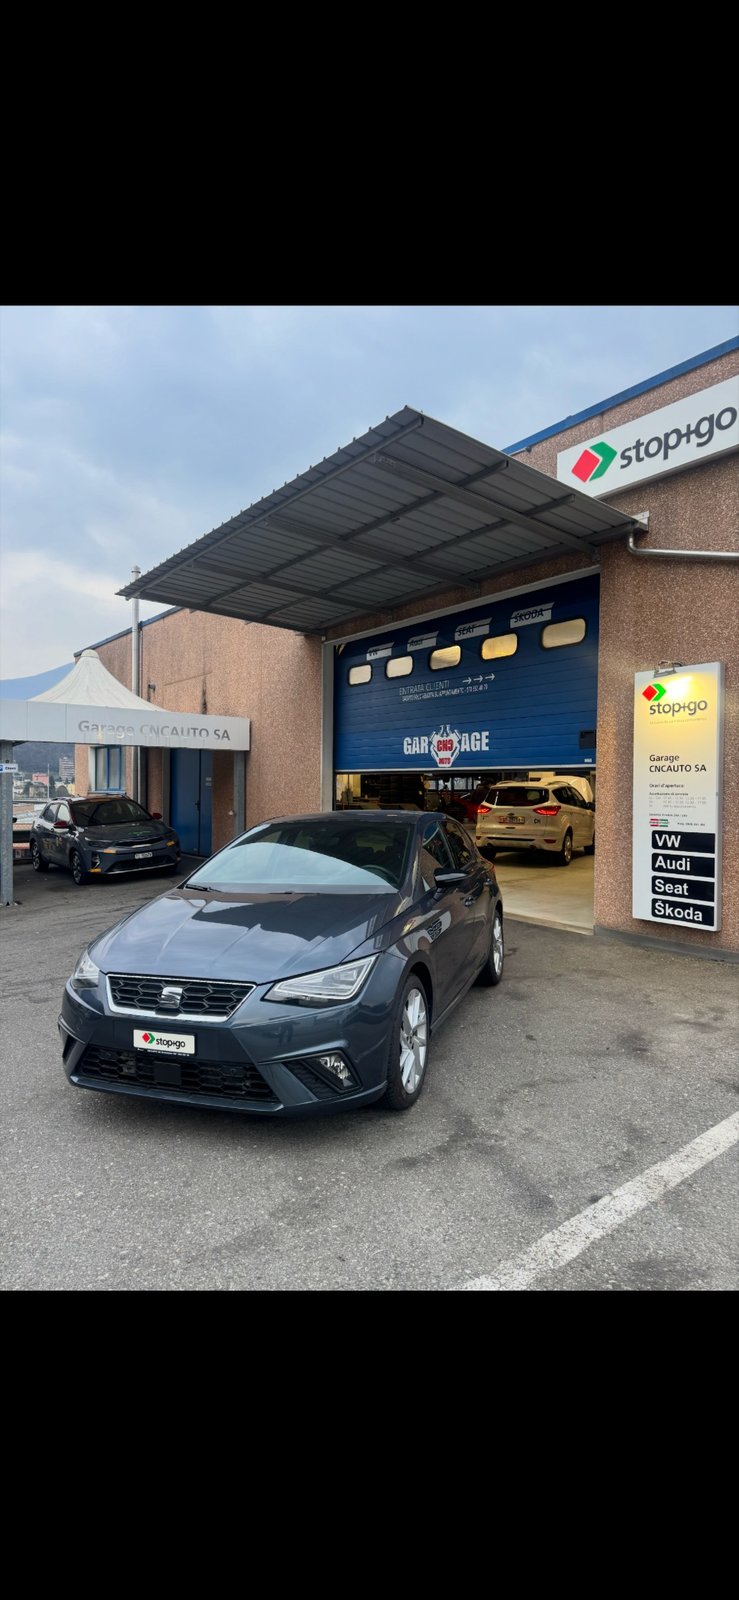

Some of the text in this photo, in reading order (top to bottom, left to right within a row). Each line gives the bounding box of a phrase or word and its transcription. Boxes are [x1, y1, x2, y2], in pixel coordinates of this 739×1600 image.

[619, 406, 738, 469] stop+go
[649, 700, 708, 717] stop+go
[78, 719, 231, 741] Garage CNCAUTO SA
[649, 754, 680, 763] Garage
[649, 764, 707, 773] CNCAUTO SA
[655, 834, 681, 848] VW
[654, 856, 691, 872] Audi
[654, 879, 689, 896] Seat
[654, 900, 703, 922] Škoda
[155, 1038, 186, 1049] stop+go
